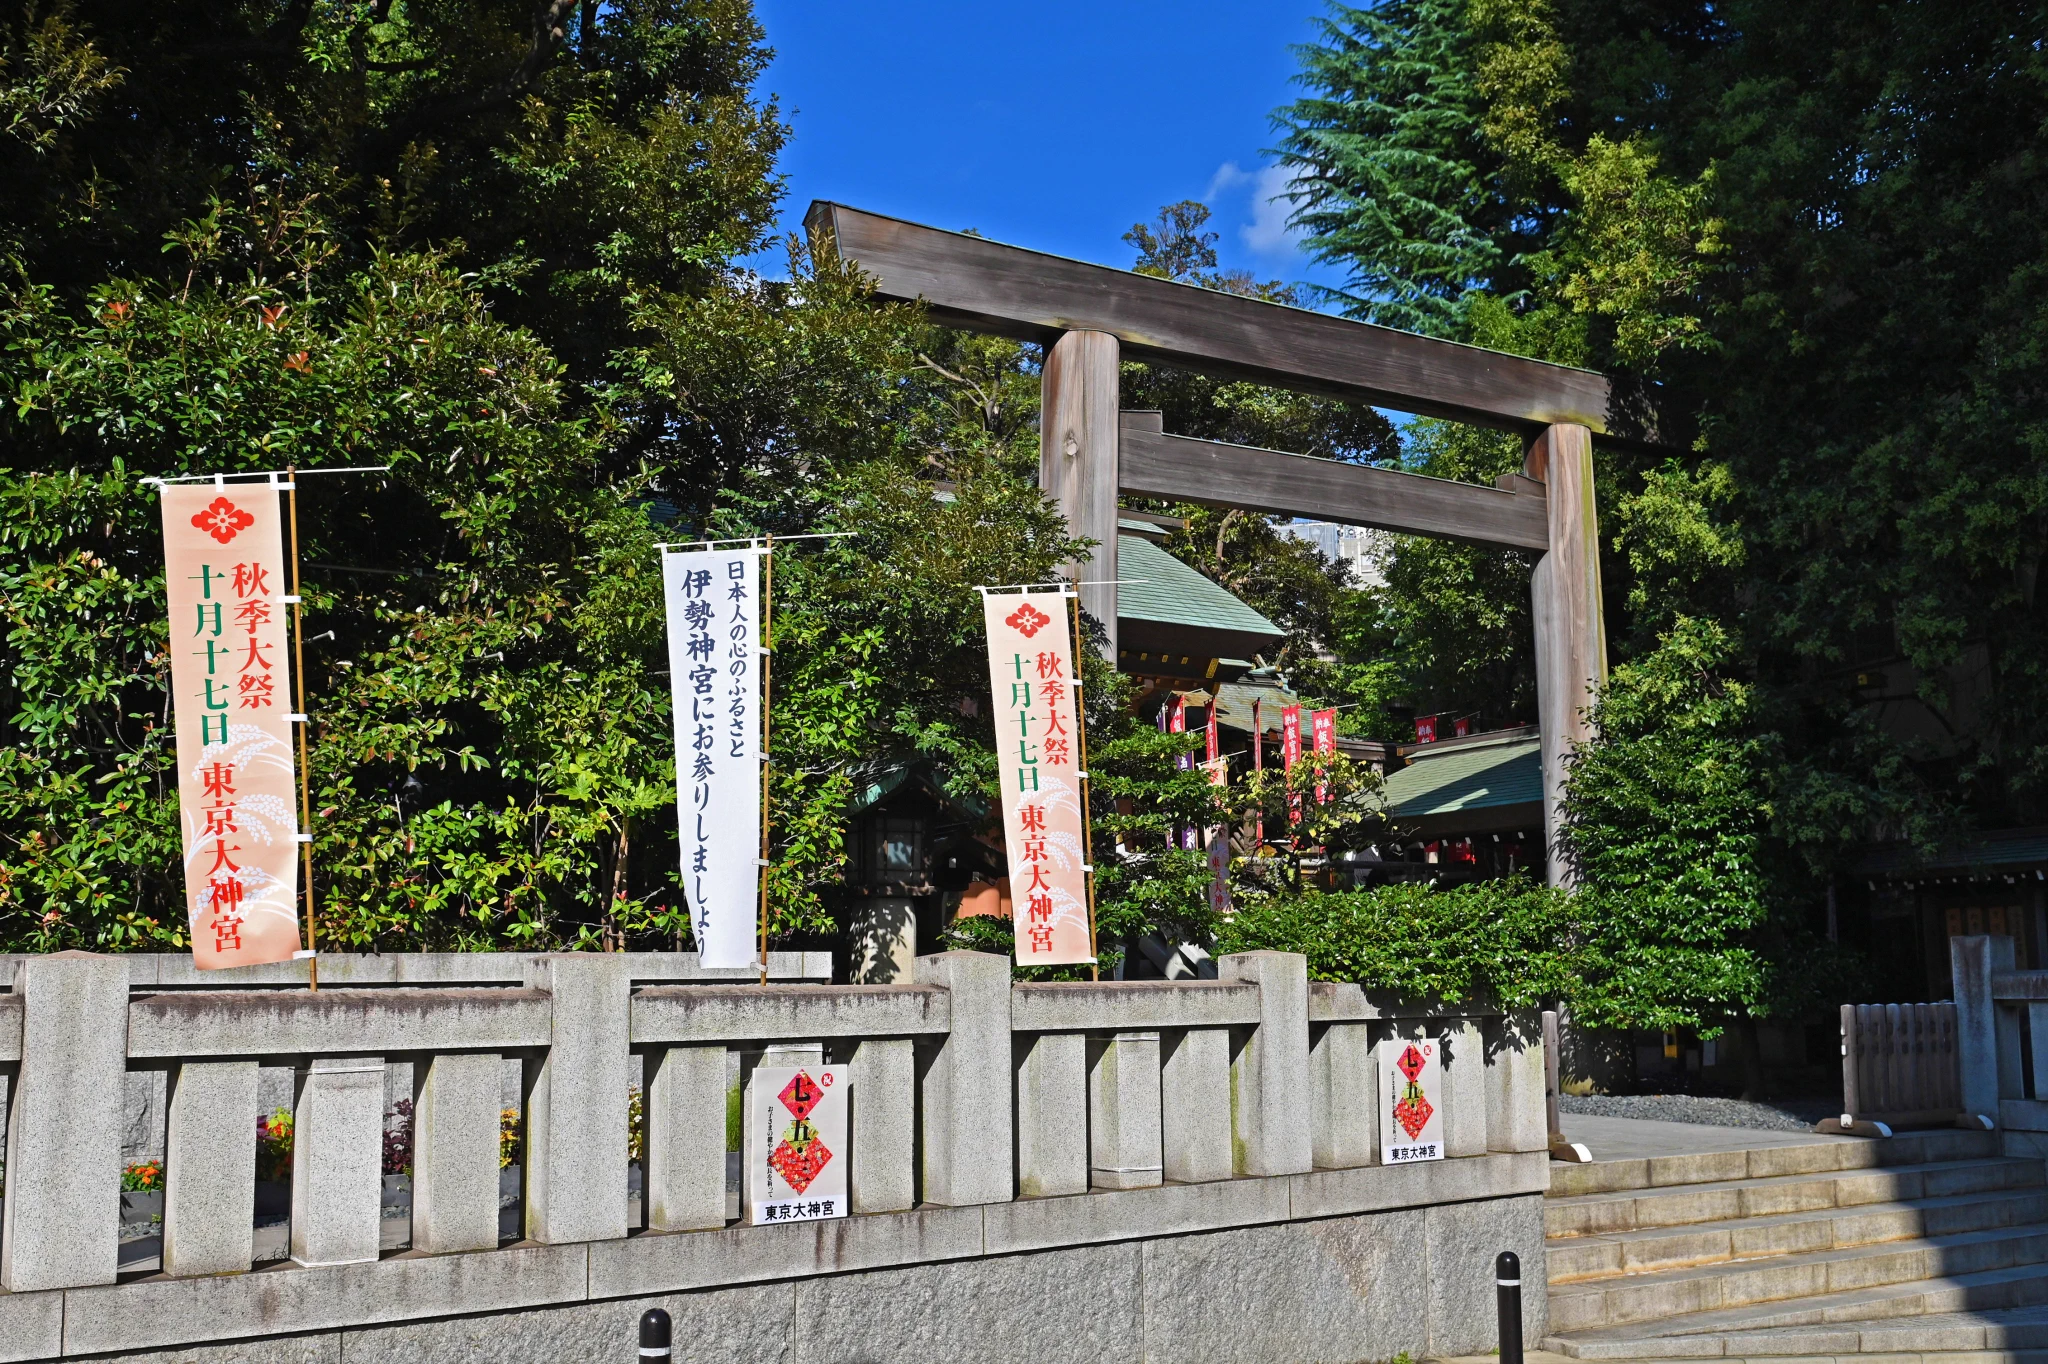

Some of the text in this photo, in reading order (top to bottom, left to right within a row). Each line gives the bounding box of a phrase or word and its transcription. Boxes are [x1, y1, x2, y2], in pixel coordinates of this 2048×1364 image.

[187, 564, 230, 747] 十月十七日
[231, 562, 274, 709] 秋季大祭
[727, 560, 749, 758] 日本人の心のふるさと
[1036, 651, 1070, 766] 秋季大祭
[681, 569, 718, 958] 伊勢神宮にお参りしましょう
[1005, 653, 1040, 793] 十月十七日
[200, 762, 244, 953] 東京大神宮
[1018, 804, 1055, 953] 東京大神宮
[765, 1200, 835, 1221] 東京大神宮
[1391, 1144, 1437, 1161] 東京大神宮
